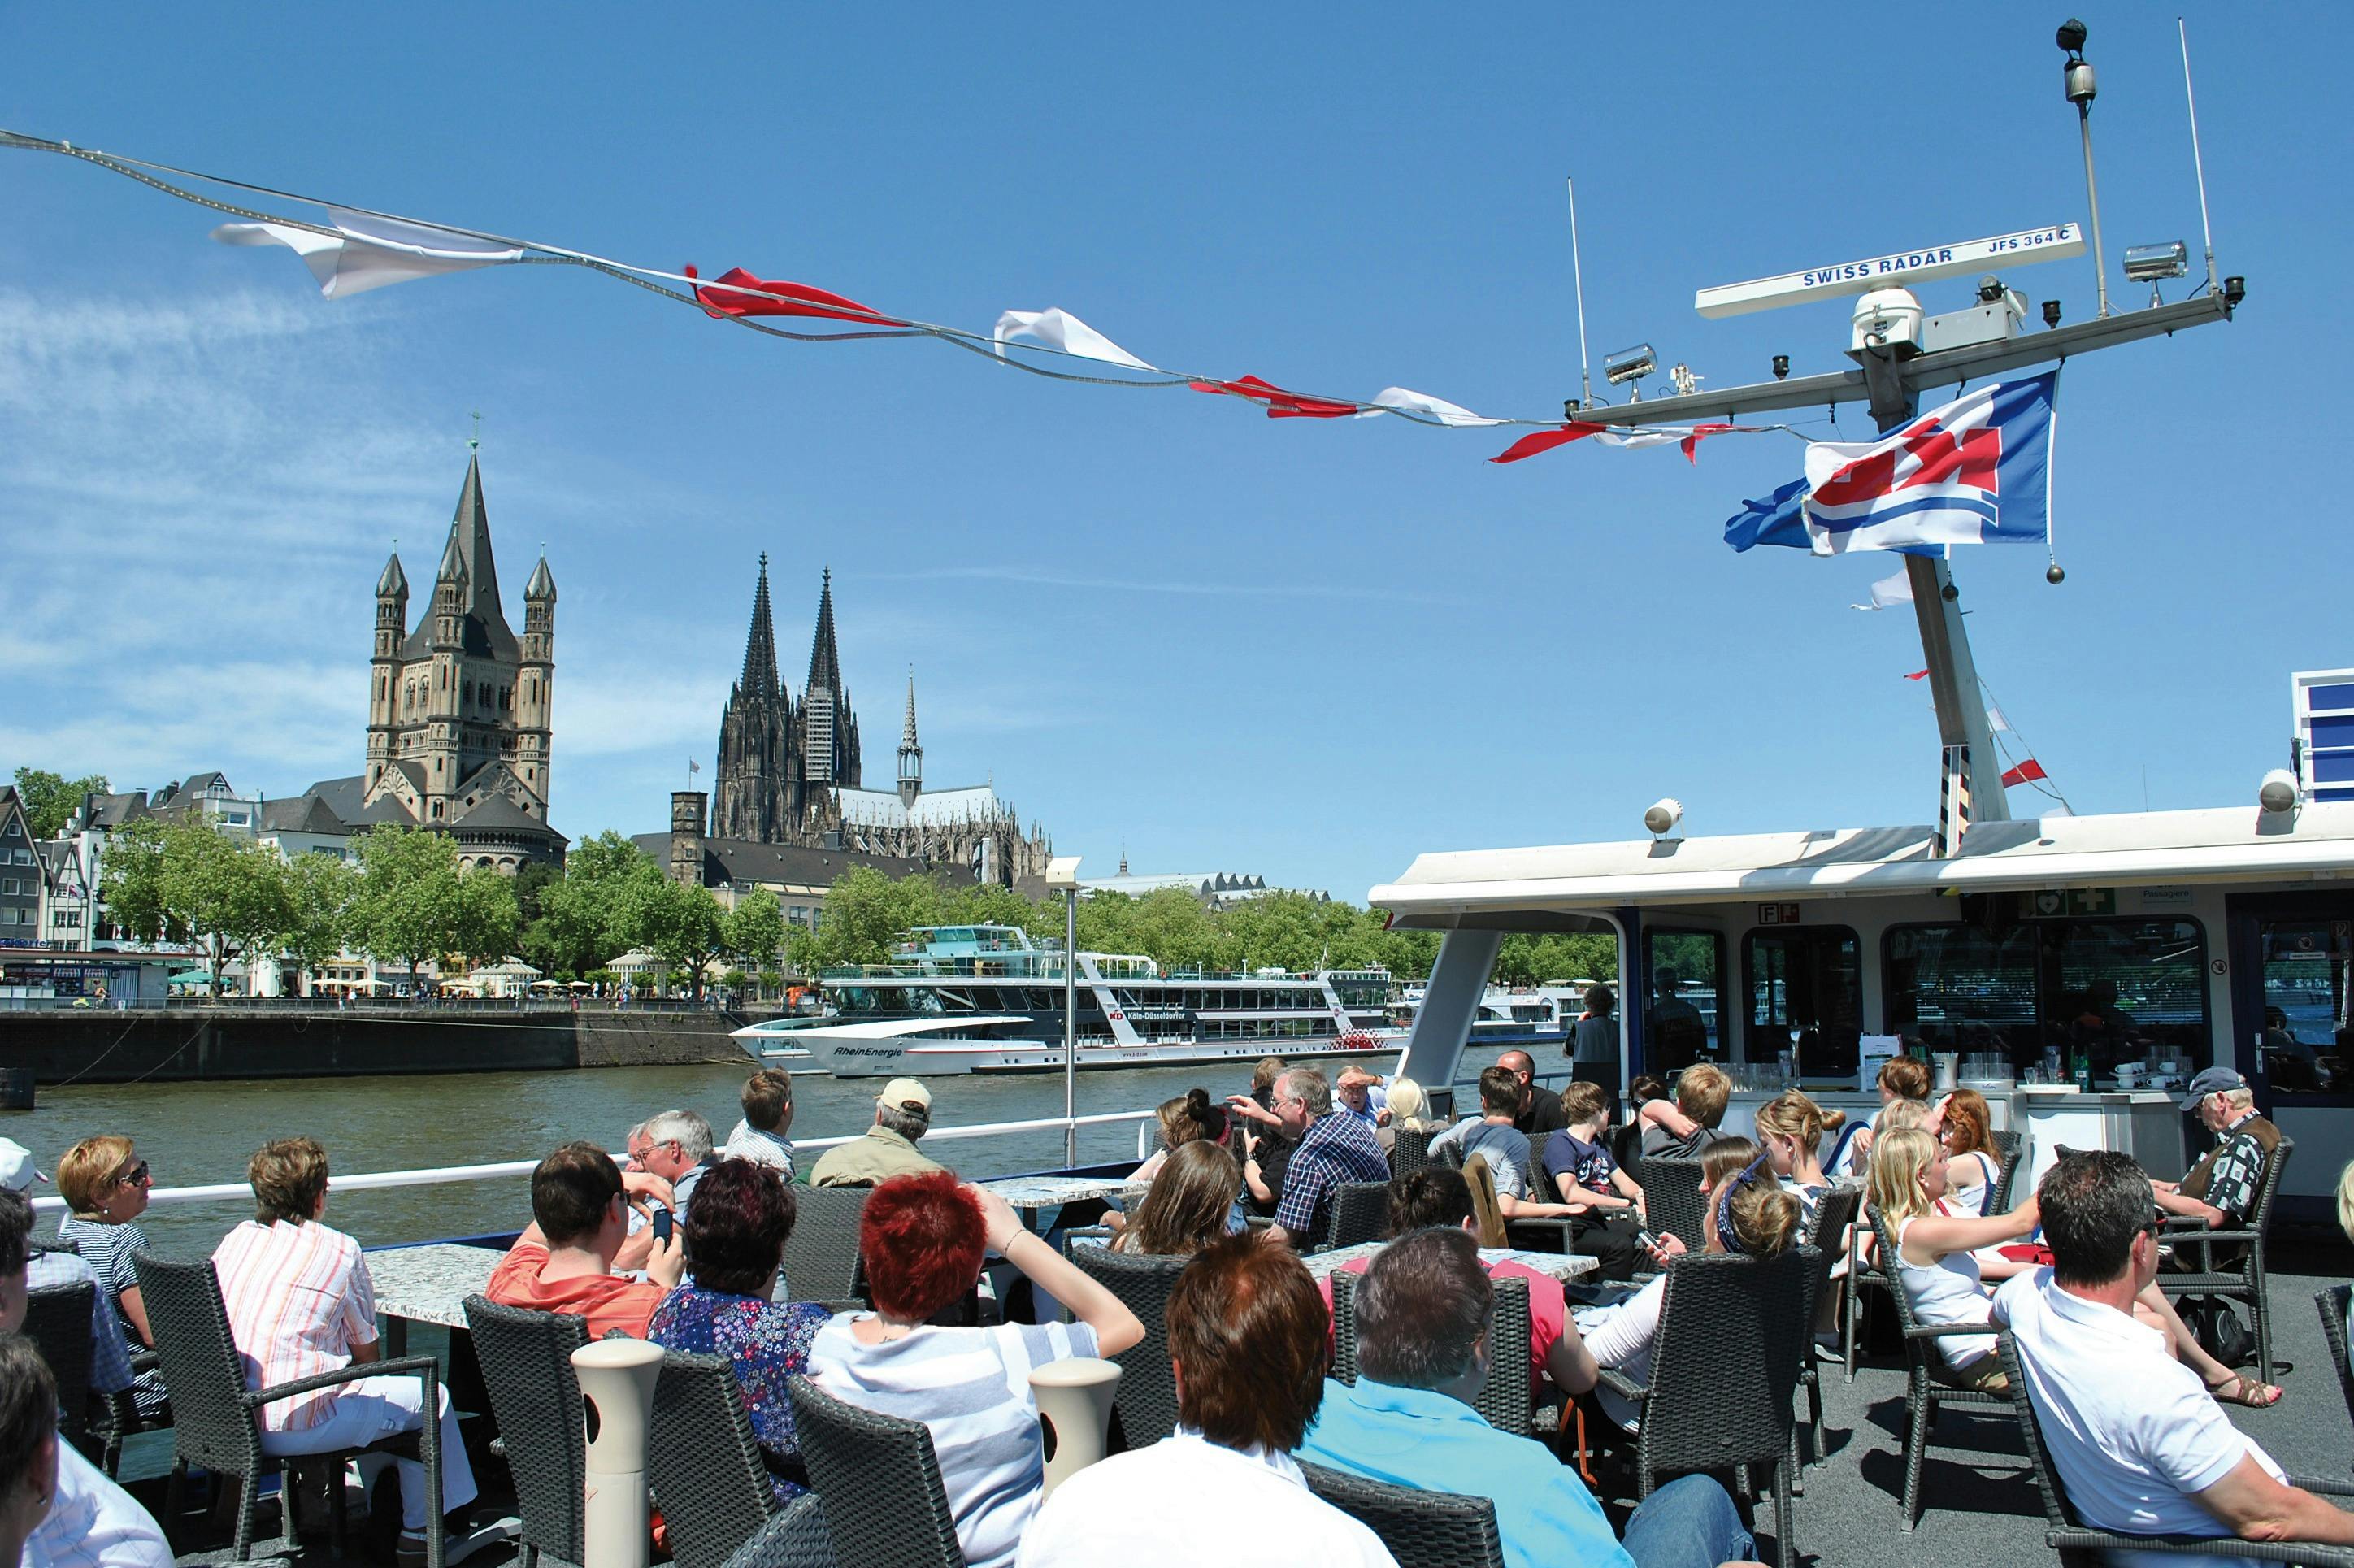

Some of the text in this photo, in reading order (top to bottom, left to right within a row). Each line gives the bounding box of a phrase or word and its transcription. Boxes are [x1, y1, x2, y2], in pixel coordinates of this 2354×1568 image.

[1804, 229, 2070, 286] SWISS RADAR JFS 364 C
[1764, 906, 1774, 922] F
[1127, 1012, 1185, 1020] Köln-Düsseldorfer
[833, 1046, 902, 1058] RheinEnergie
